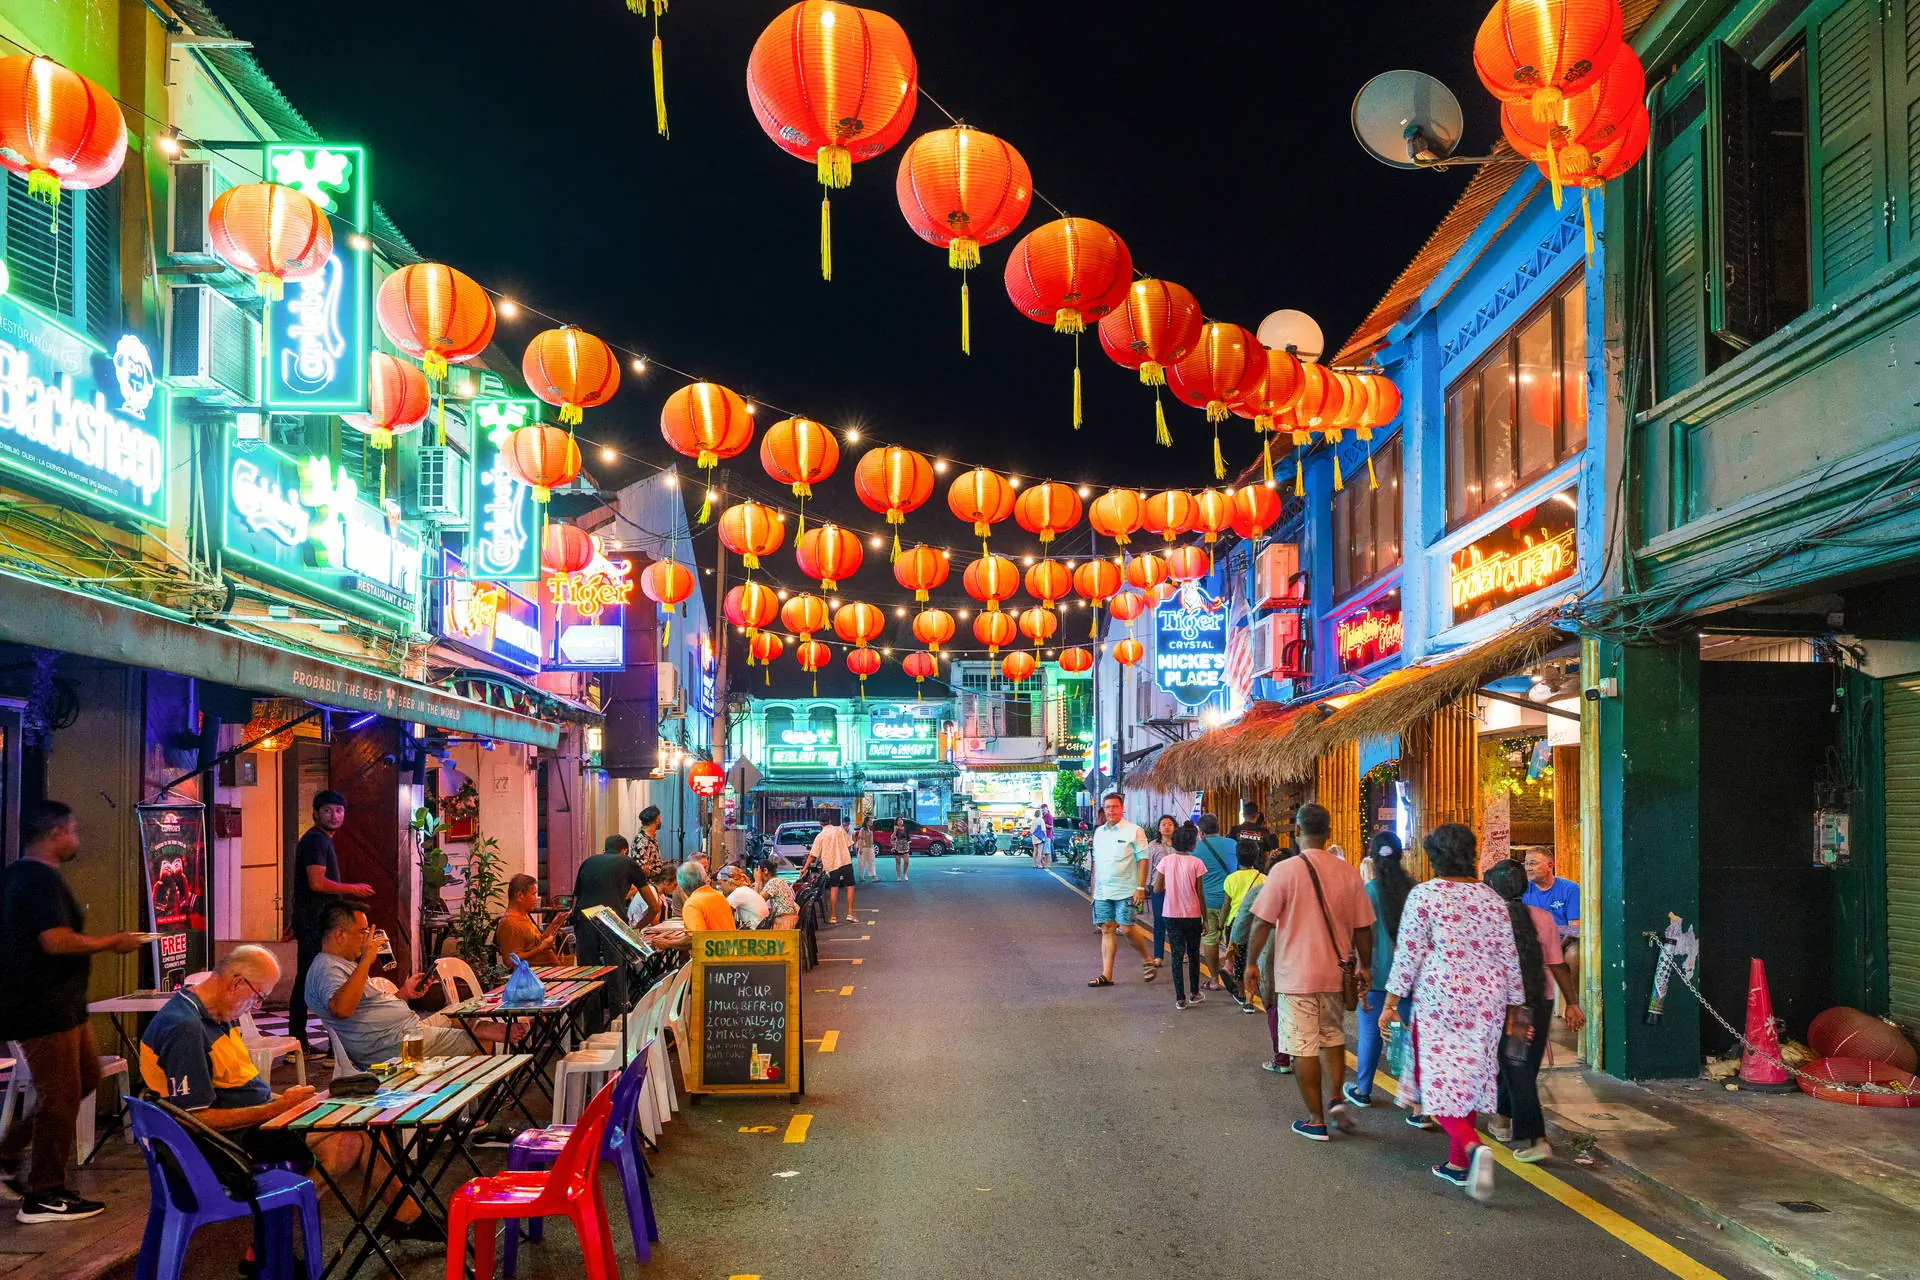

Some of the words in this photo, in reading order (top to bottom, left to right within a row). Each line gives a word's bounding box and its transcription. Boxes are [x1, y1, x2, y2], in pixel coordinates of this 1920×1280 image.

[359, 581, 397, 605] RESTAURANT
[547, 574, 633, 616] Tiger
[1158, 608, 1224, 640] Tiger
[1169, 641, 1214, 649] CRYSTAL
[1158, 654, 1225, 668] MICKE'S
[1165, 671, 1219, 687] PLACE
[293, 671, 342, 693] PROBABLY
[345, 683, 360, 697] THE
[364, 687, 382, 702] BEST
[398, 696, 415, 710] BEER
[417, 702, 425, 712] IN
[427, 704, 439, 715] THE
[440, 706, 461, 720] WORLD
[869, 744, 891, 756] DAY
[898, 744, 934, 756] NIGHT
[161, 933, 187, 956] FREE
[704, 939, 785, 957] SOMERSBY
[709, 972, 749, 986] HAPPY
[738, 985, 771, 997] HOUR
[170, 1075, 191, 1096] 14
